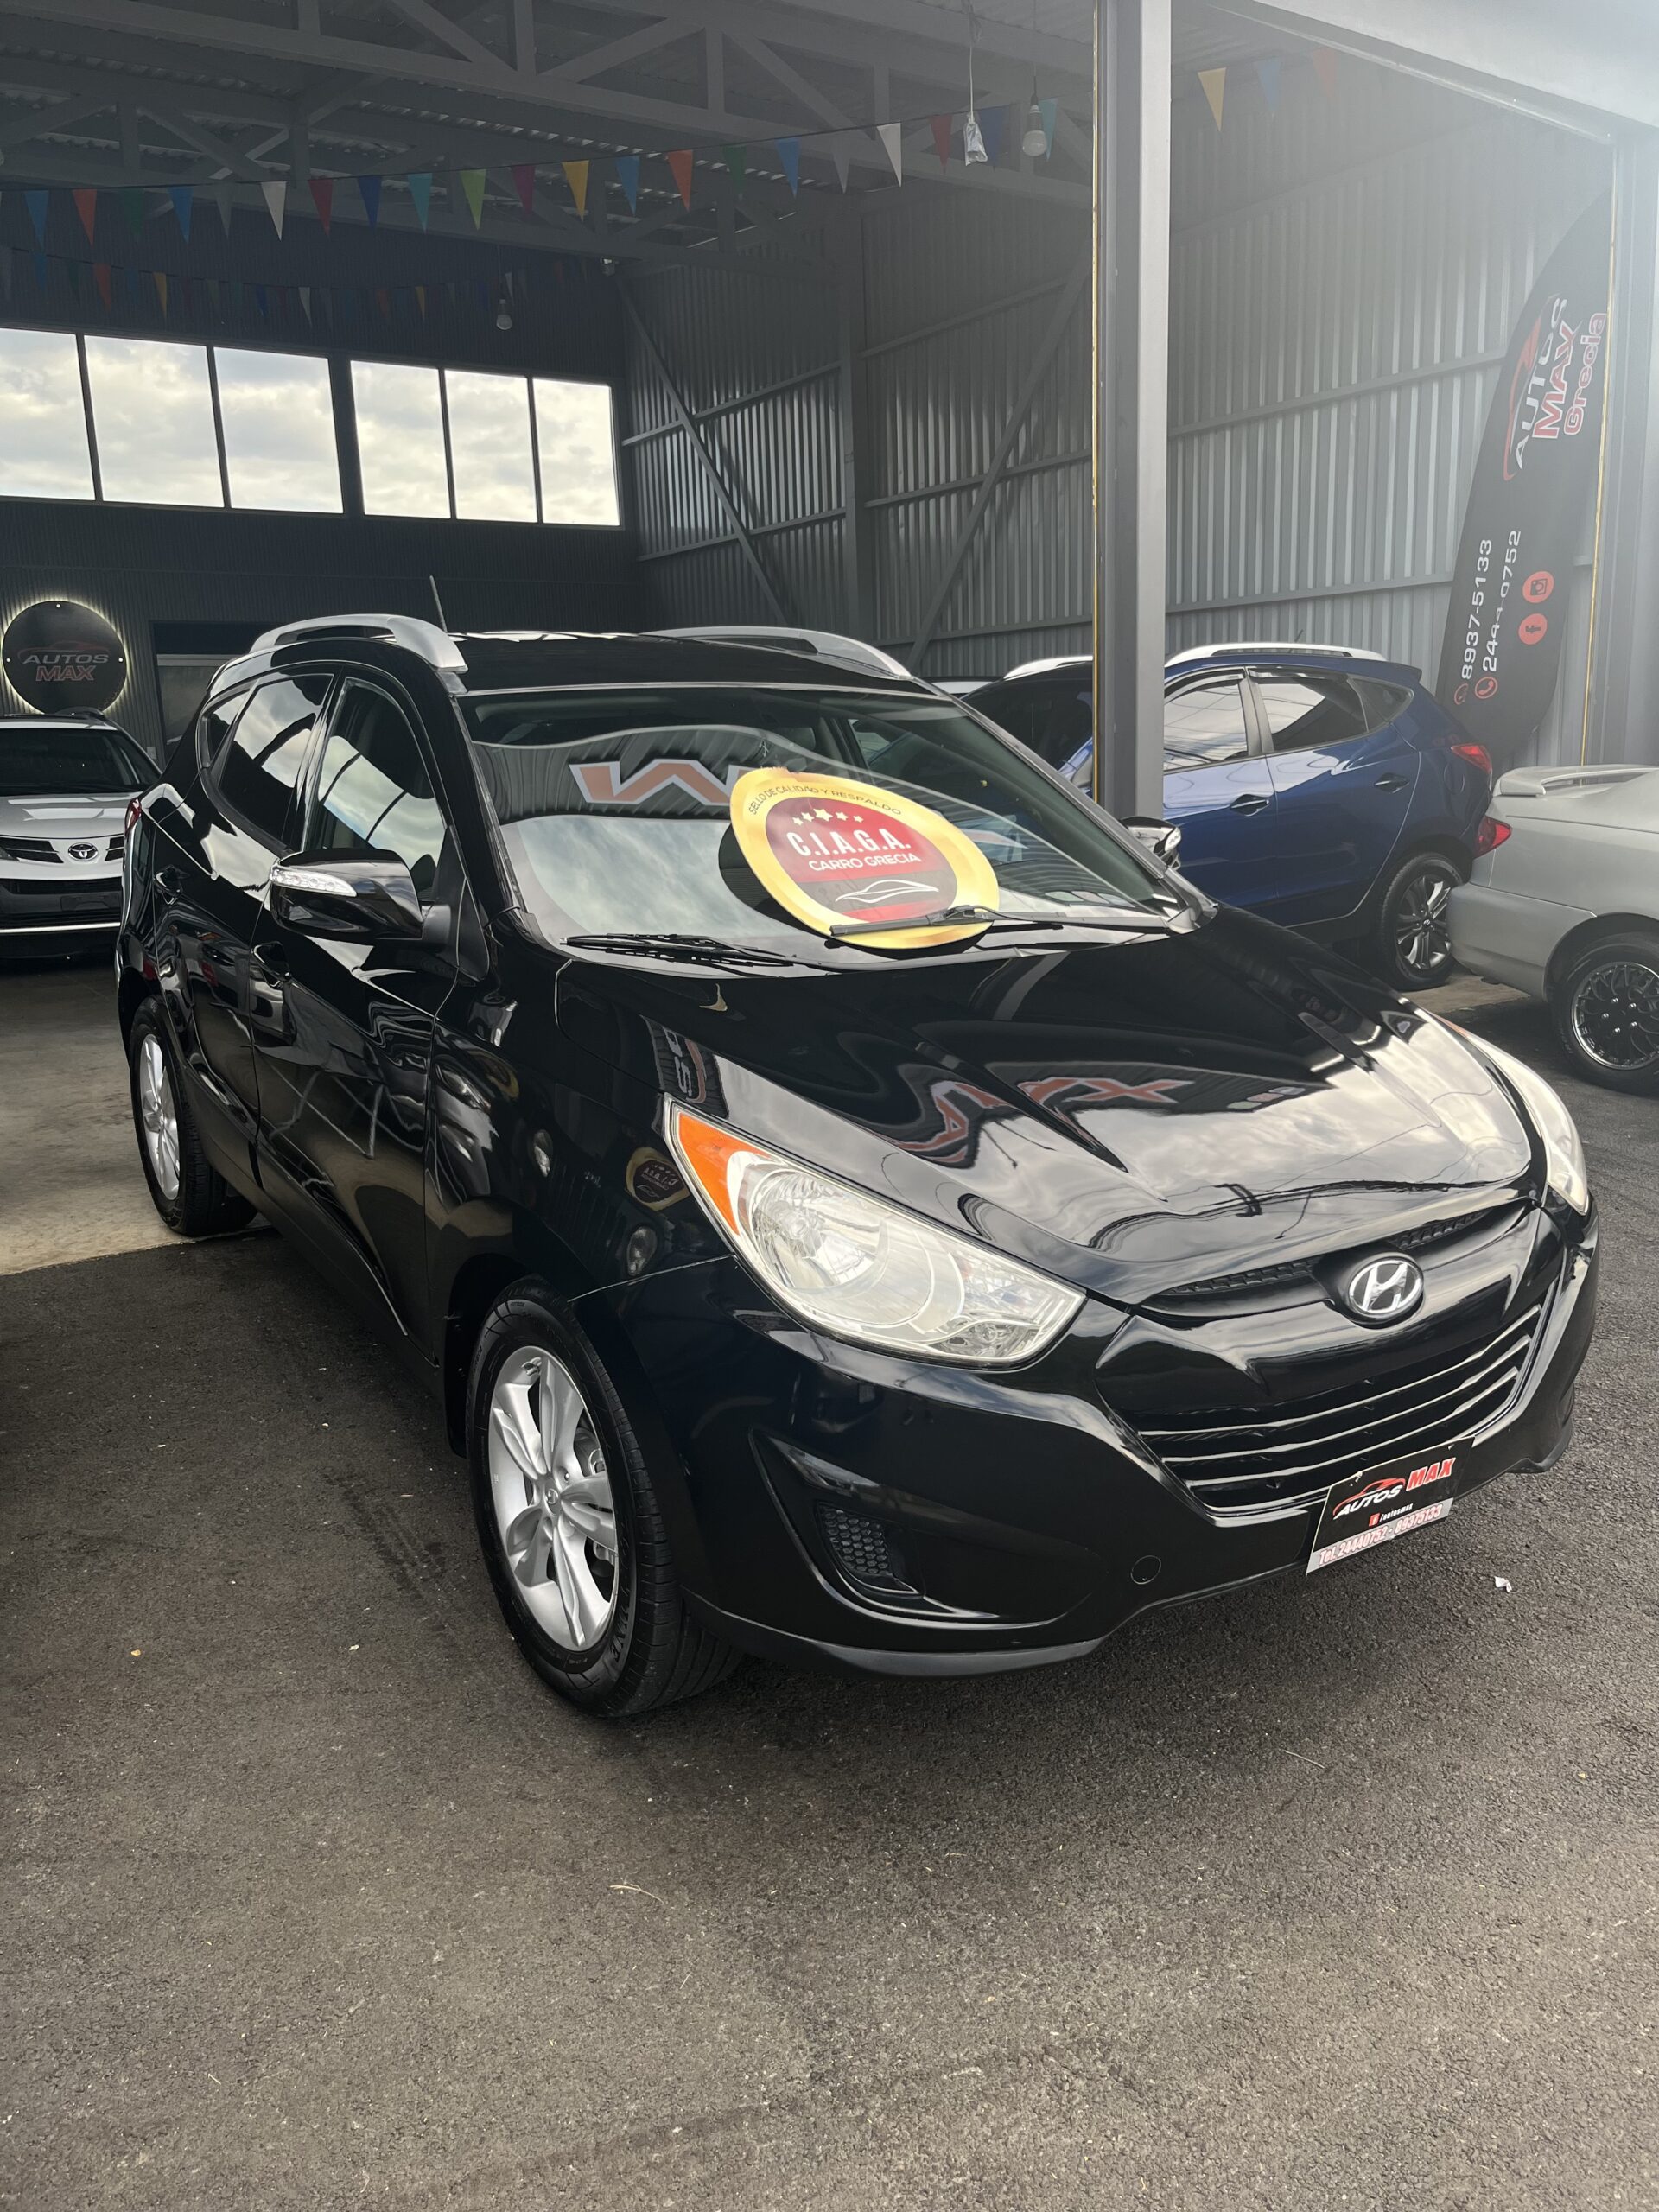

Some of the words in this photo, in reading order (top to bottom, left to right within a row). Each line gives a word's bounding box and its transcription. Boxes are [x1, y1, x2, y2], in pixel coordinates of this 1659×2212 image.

[1515, 298, 1567, 469] AUTOS
[1532, 319, 1582, 439] MAX
[1563, 312, 1607, 435] Grecia
[1461, 539, 1492, 680] 8937-5133
[1482, 530, 1522, 672] 2444-0752
[23, 654, 110, 664] AUTOS
[35, 665, 97, 682] MAX
[748, 792, 767, 815] SELLO
[764, 787, 776, 798] DE
[830, 790, 902, 816] RESPALDO
[786, 828, 912, 856] C.I.A.G.A.
[808, 857, 864, 871] CARRO
[863, 852, 921, 868] GRECIA
[1333, 1484, 1404, 1520] AUTOS
[1405, 1457, 1456, 1491] MAX
[1338, 1528, 1388, 1558] 24440752
[1393, 1503, 1443, 1535] 89375133
